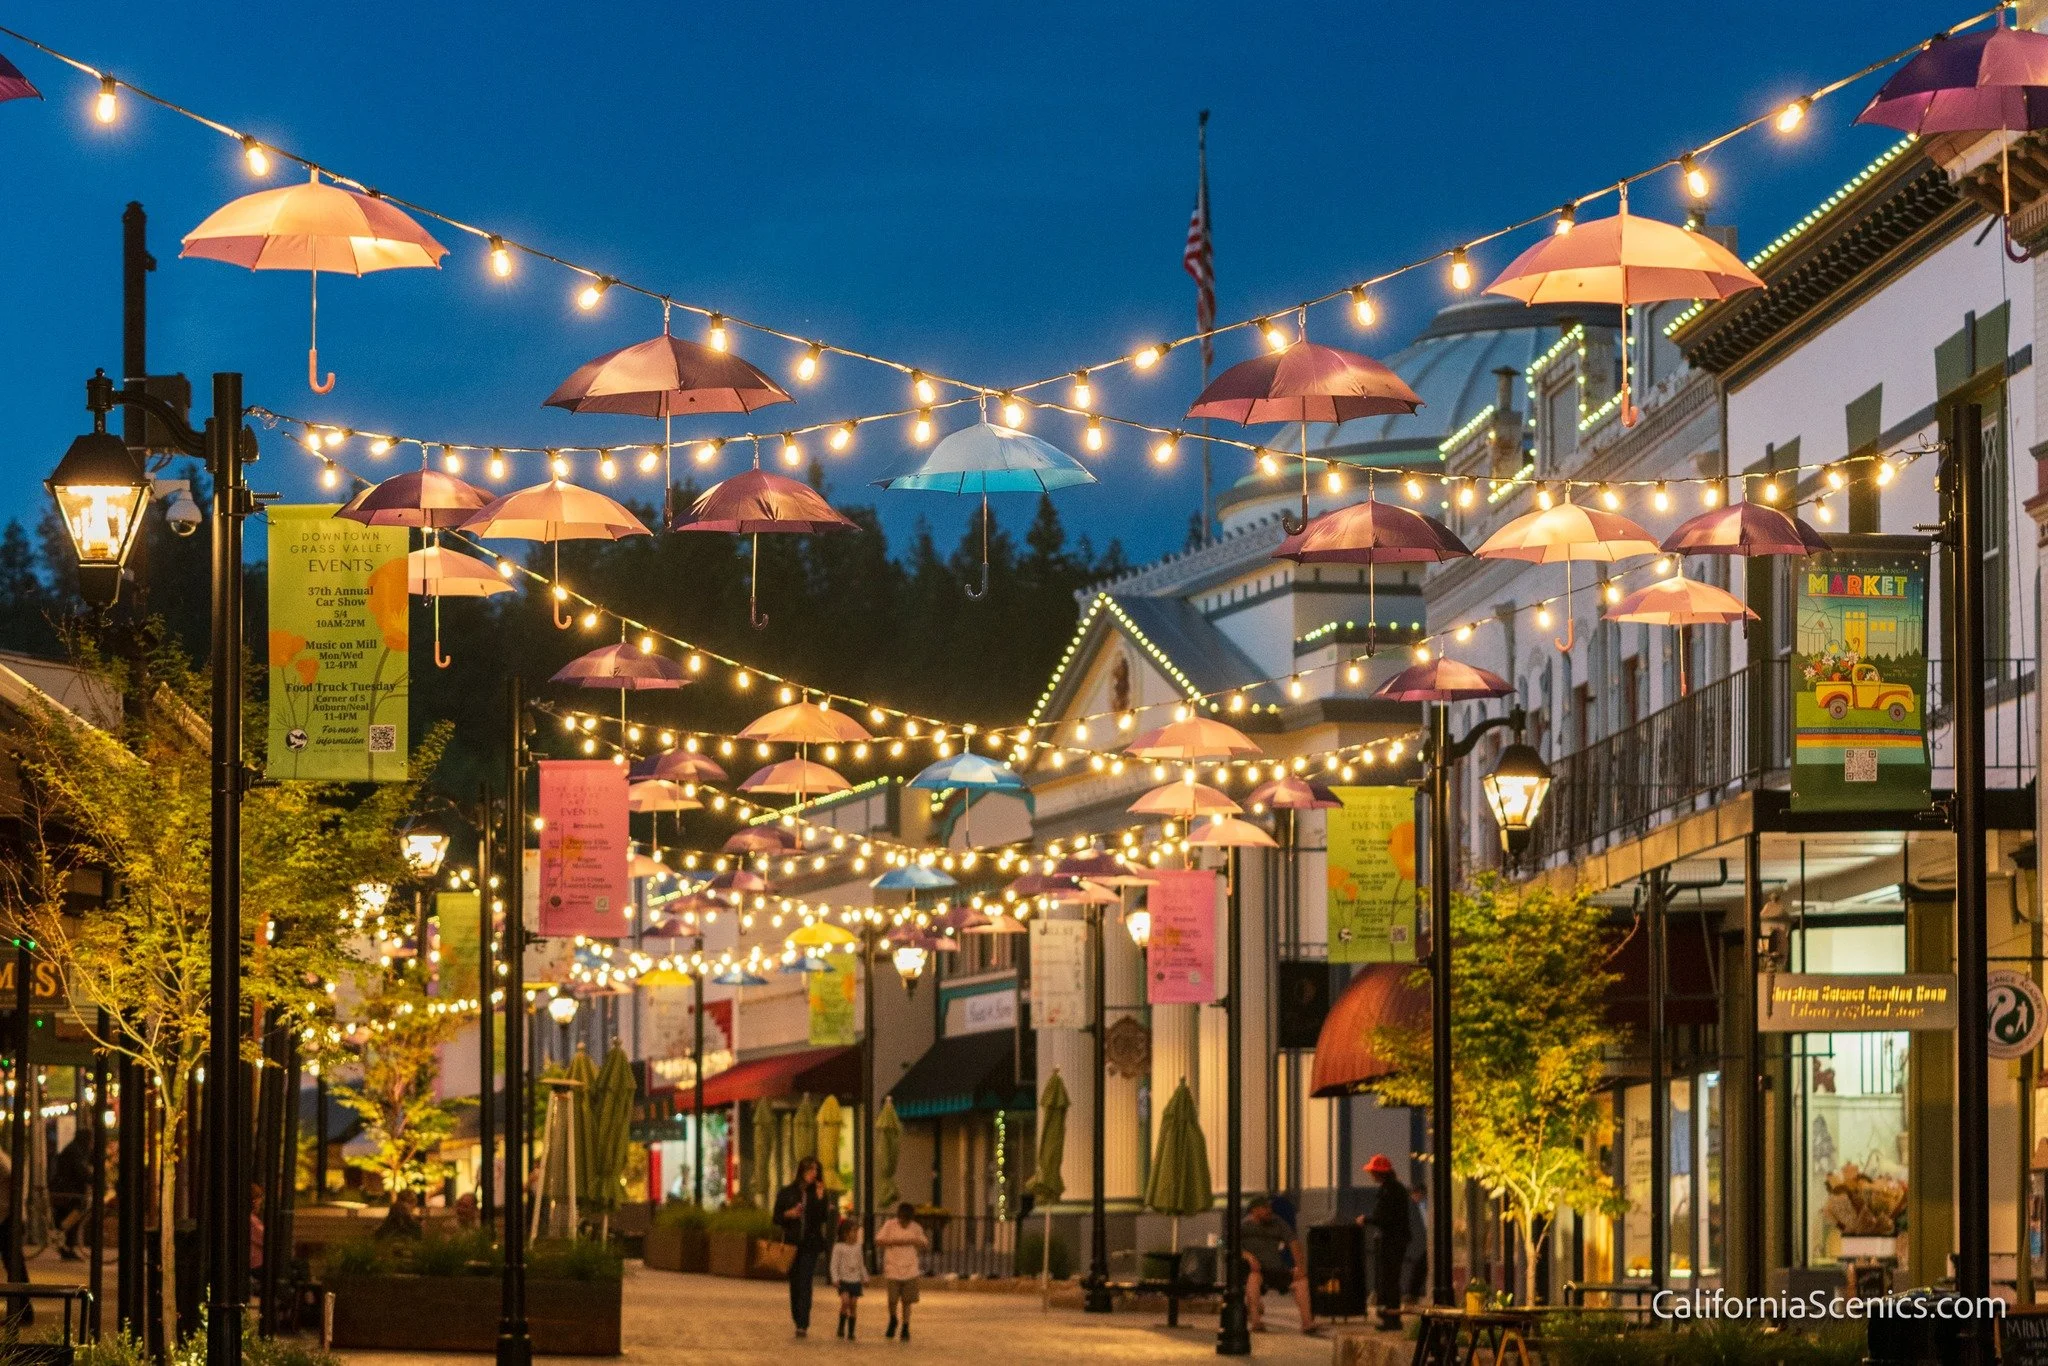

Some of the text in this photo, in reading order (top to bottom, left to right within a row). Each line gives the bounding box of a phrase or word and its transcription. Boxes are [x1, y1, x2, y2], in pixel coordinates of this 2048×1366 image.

[302, 532, 380, 541] DOWNTOWN
[290, 544, 392, 554] GRASS VALLEY
[308, 558, 374, 572] EVENTS
[1808, 574, 1908, 596] MARKET
[308, 586, 374, 596] 37th Annual
[316, 598, 367, 607] Car Show
[334, 610, 347, 619] 5/4
[316, 619, 365, 628] 10AM-2PM
[305, 640, 377, 650] Music on Mill
[319, 651, 363, 660] Mon/Wed
[325, 661, 358, 669] 12-4PM
[286, 682, 396, 693] Food Truck Tuesday
[316, 695, 347, 703] Corner
[313, 703, 369, 711] Auburn/Neal
[324, 713, 357, 721] 11-4PM
[315, 736, 365, 746] information
[1351, 821, 1393, 831] EVENTS
[1822, 985, 1865, 1002] Science
[1868, 985, 1912, 1003] Reading
[1916, 985, 1947, 1002] Room
